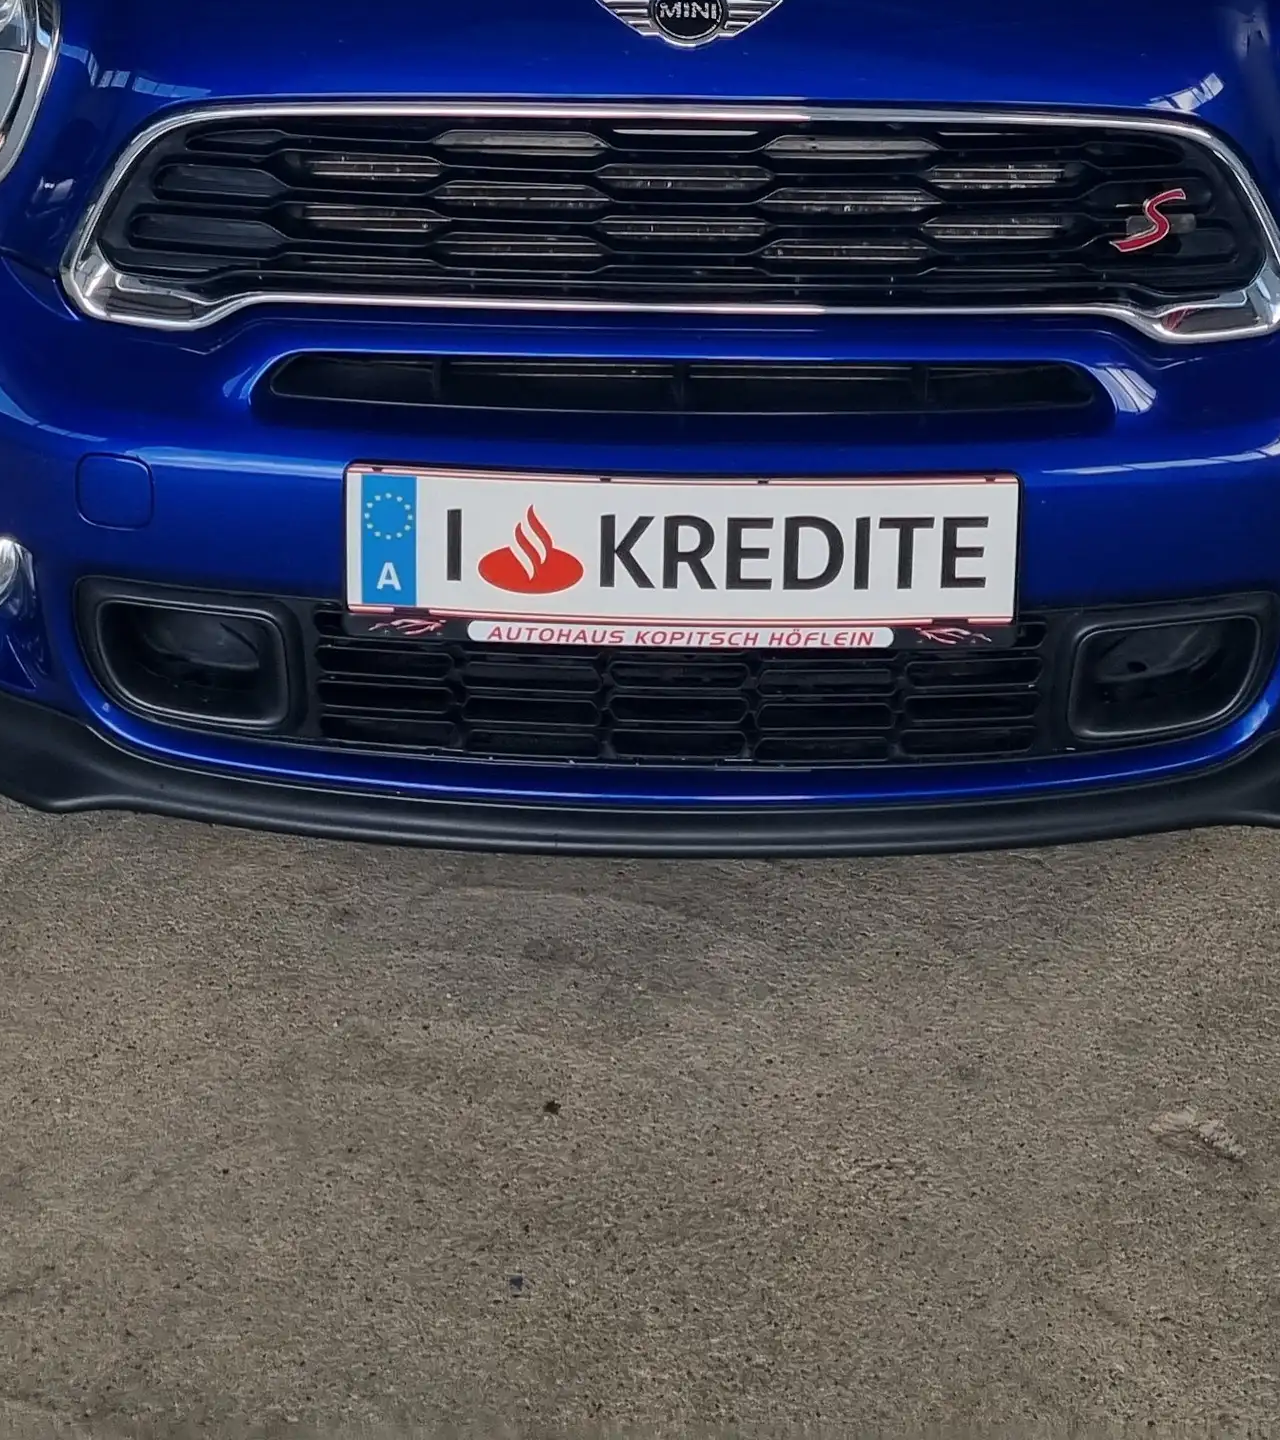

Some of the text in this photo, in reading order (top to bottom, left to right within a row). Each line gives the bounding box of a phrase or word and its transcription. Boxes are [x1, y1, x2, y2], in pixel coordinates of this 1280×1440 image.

[660, 1, 717, 19] MINI
[1109, 188, 1186, 252] S
[447, 508, 989, 590] I KREDITE
[376, 562, 401, 591] A
[487, 625, 875, 647] AUTOHAUS KOPITSCH HÖFLEIN
